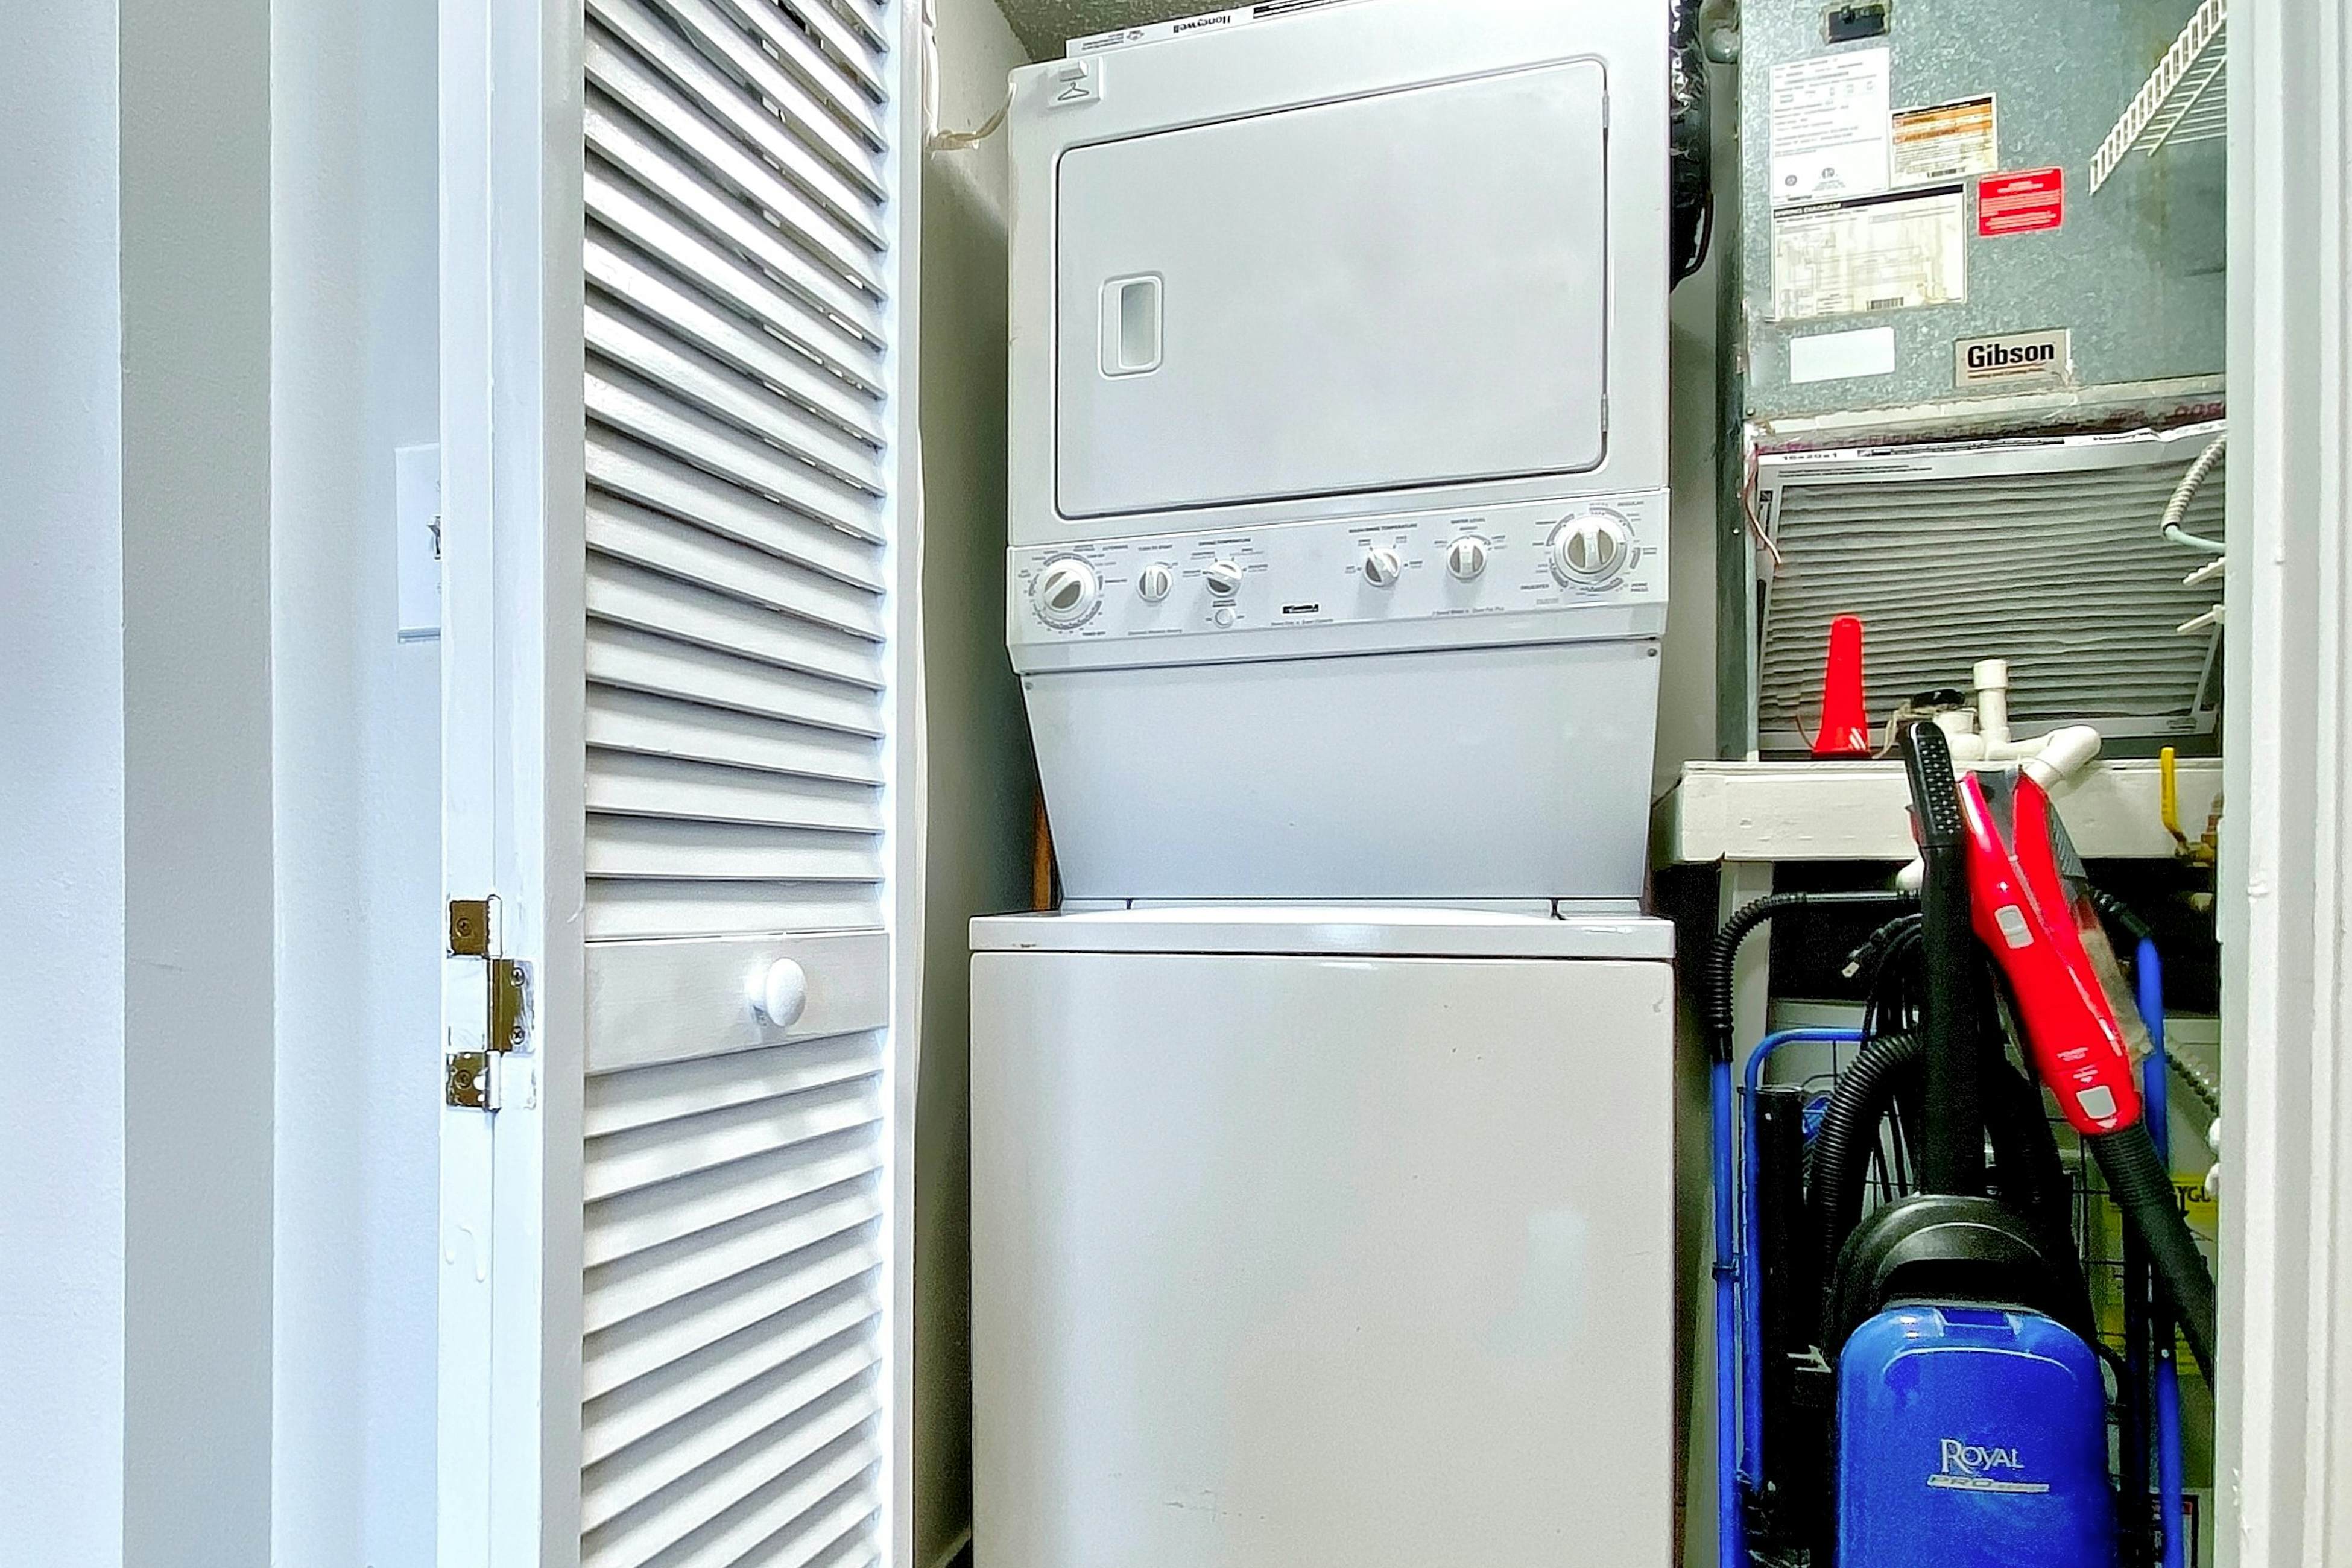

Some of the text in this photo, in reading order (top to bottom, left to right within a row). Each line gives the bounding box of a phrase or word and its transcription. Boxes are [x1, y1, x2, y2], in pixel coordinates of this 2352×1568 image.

[1173, 15, 1231, 34] Honeywell
[1967, 343, 2055, 368] Gibson
[1940, 1438, 2025, 1474] ROYAL
